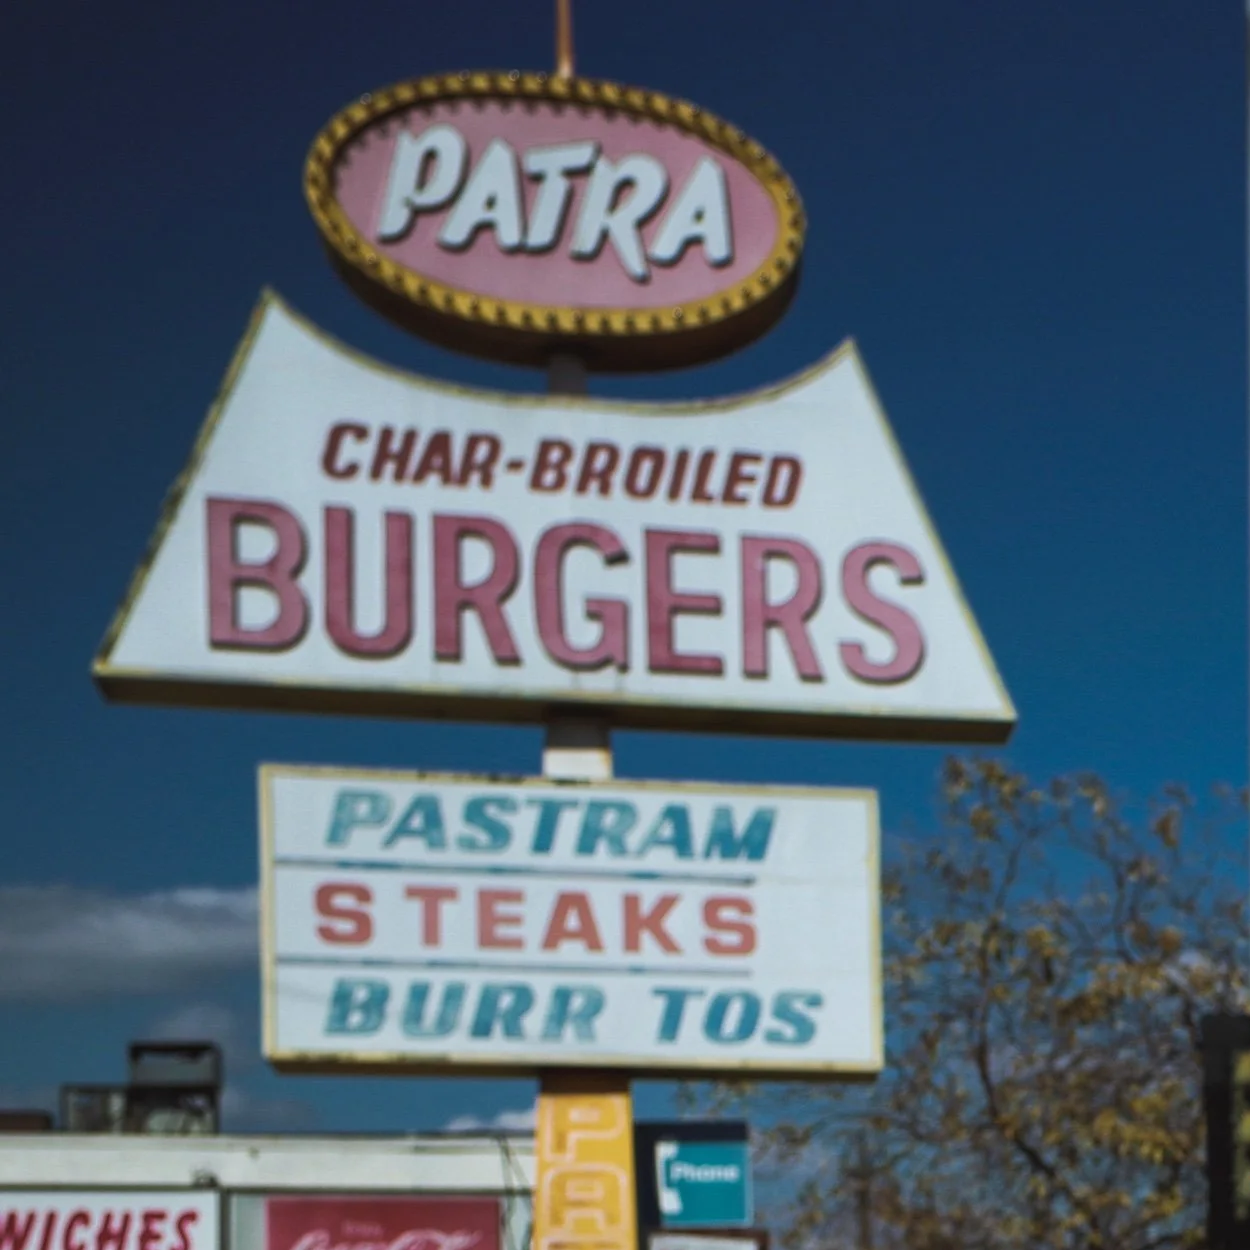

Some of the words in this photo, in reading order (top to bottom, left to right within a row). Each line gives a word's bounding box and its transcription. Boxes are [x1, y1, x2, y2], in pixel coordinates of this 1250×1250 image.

[377, 122, 735, 283] PATRA
[320, 420, 804, 510] CHAR-BROILED
[206, 496, 925, 687] BURGERS
[325, 788, 777, 862] PASTRAM
[314, 882, 757, 957] STEAKS
[324, 977, 606, 1041] BURR
[651, 985, 824, 1047] TOS
[670, 1162, 740, 1183] Phone
